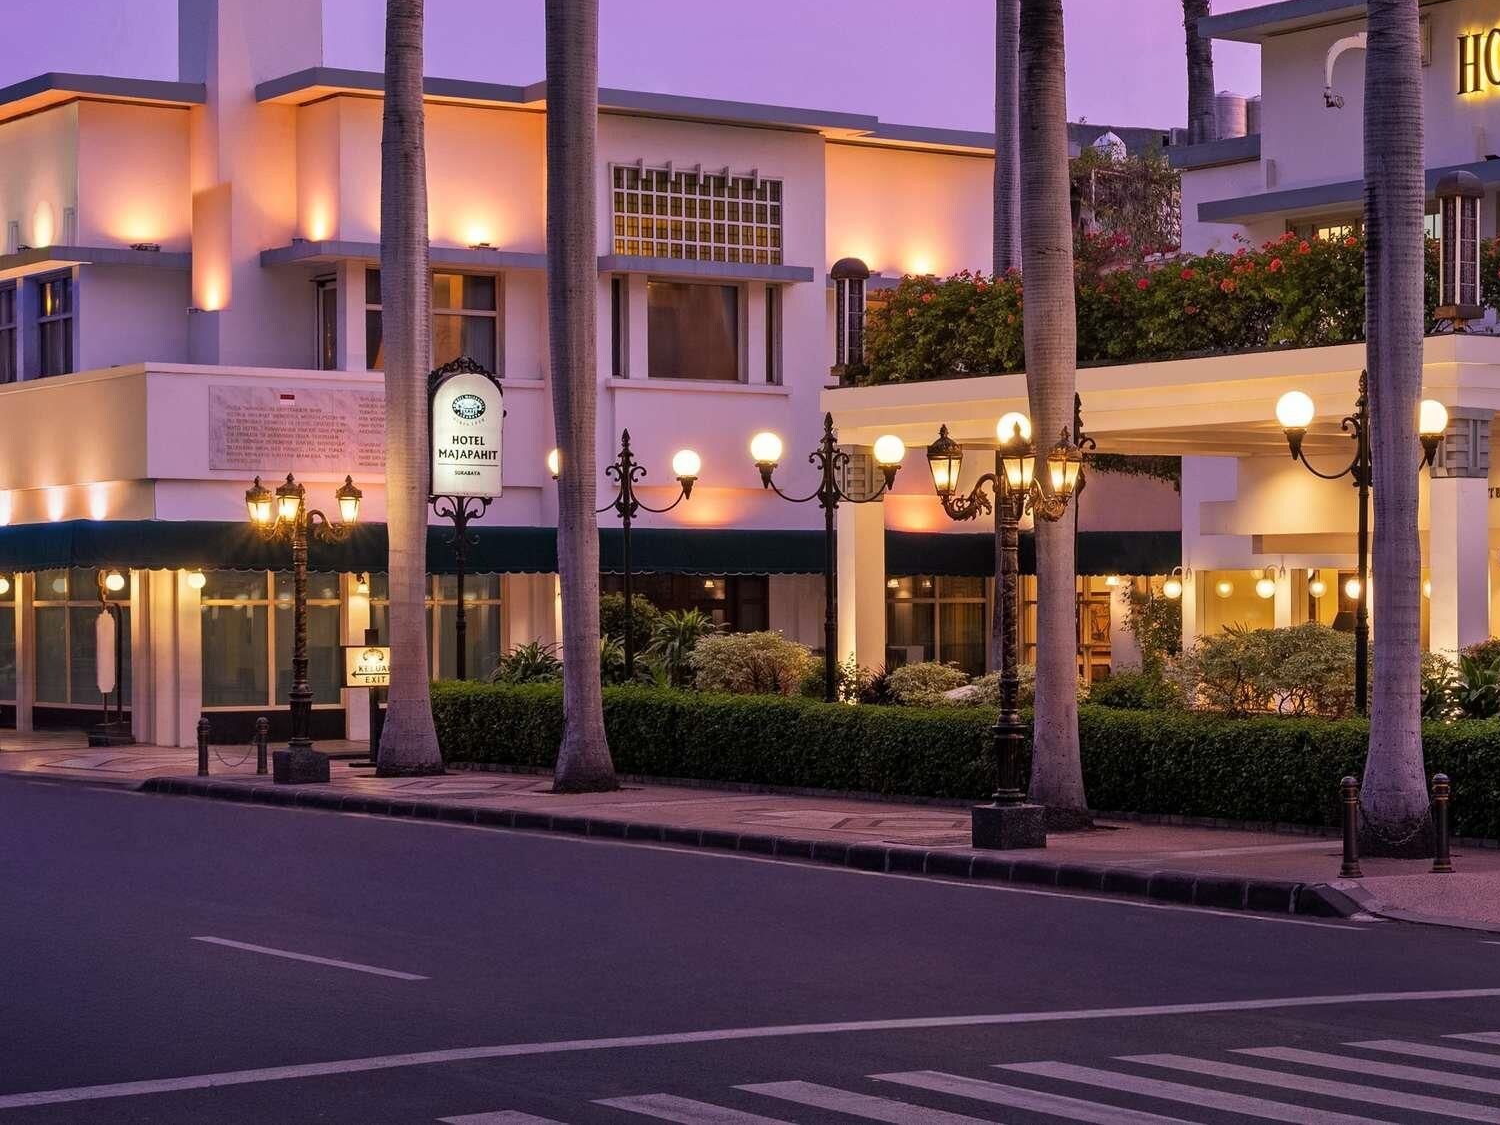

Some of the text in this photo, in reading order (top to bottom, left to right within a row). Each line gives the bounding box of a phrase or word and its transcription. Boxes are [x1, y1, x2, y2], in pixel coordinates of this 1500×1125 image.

[452, 435, 486, 446] HOTEL
[438, 448, 498, 460] MAJAPAHIT
[365, 676, 386, 684] EXIT
